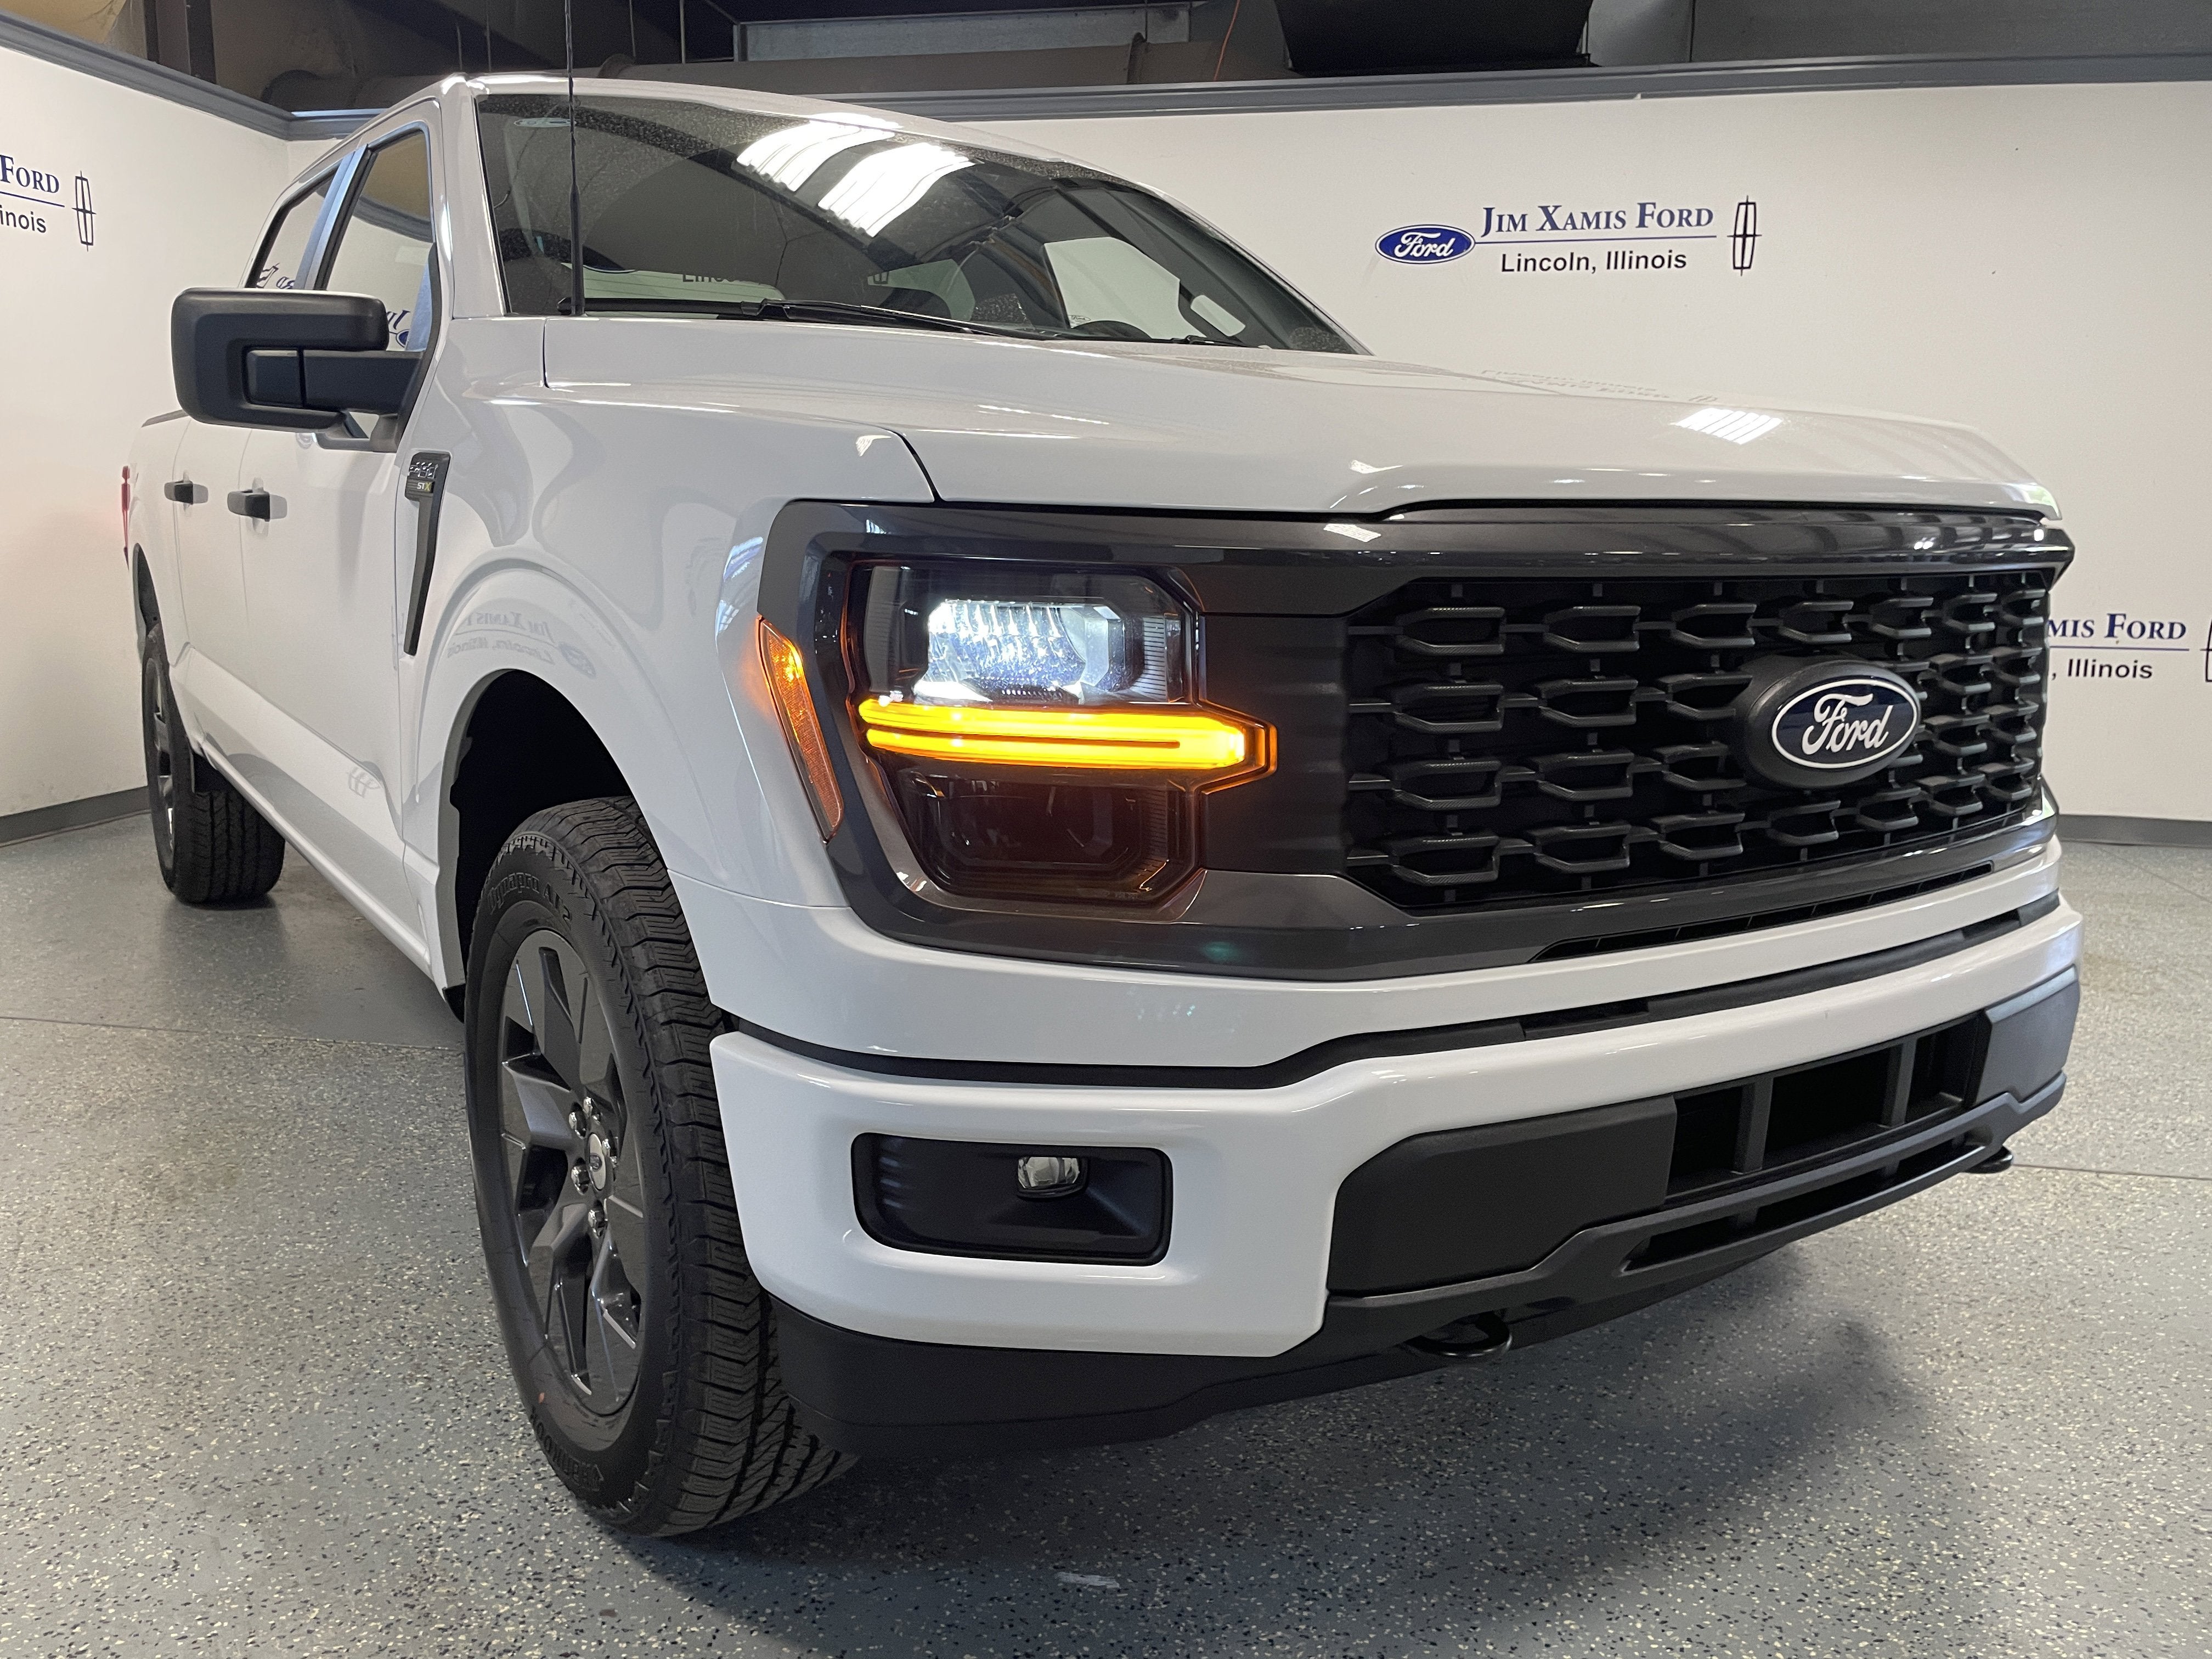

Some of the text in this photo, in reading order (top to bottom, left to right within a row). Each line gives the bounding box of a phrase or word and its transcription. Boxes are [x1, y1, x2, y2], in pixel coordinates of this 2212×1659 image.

[0, 154, 59, 193] FORD
[0, 205, 47, 233] inois
[1481, 202, 1714, 238] JIM XAMIS FORD
[1393, 232, 1455, 257] Ford
[1502, 250, 1687, 274] Lincoln, Illinois
[417, 482, 432, 492] STX
[2047, 613, 2187, 640] MIS FORD
[2067, 658, 2153, 679] Illinois
[1802, 693, 1894, 755] Ford
